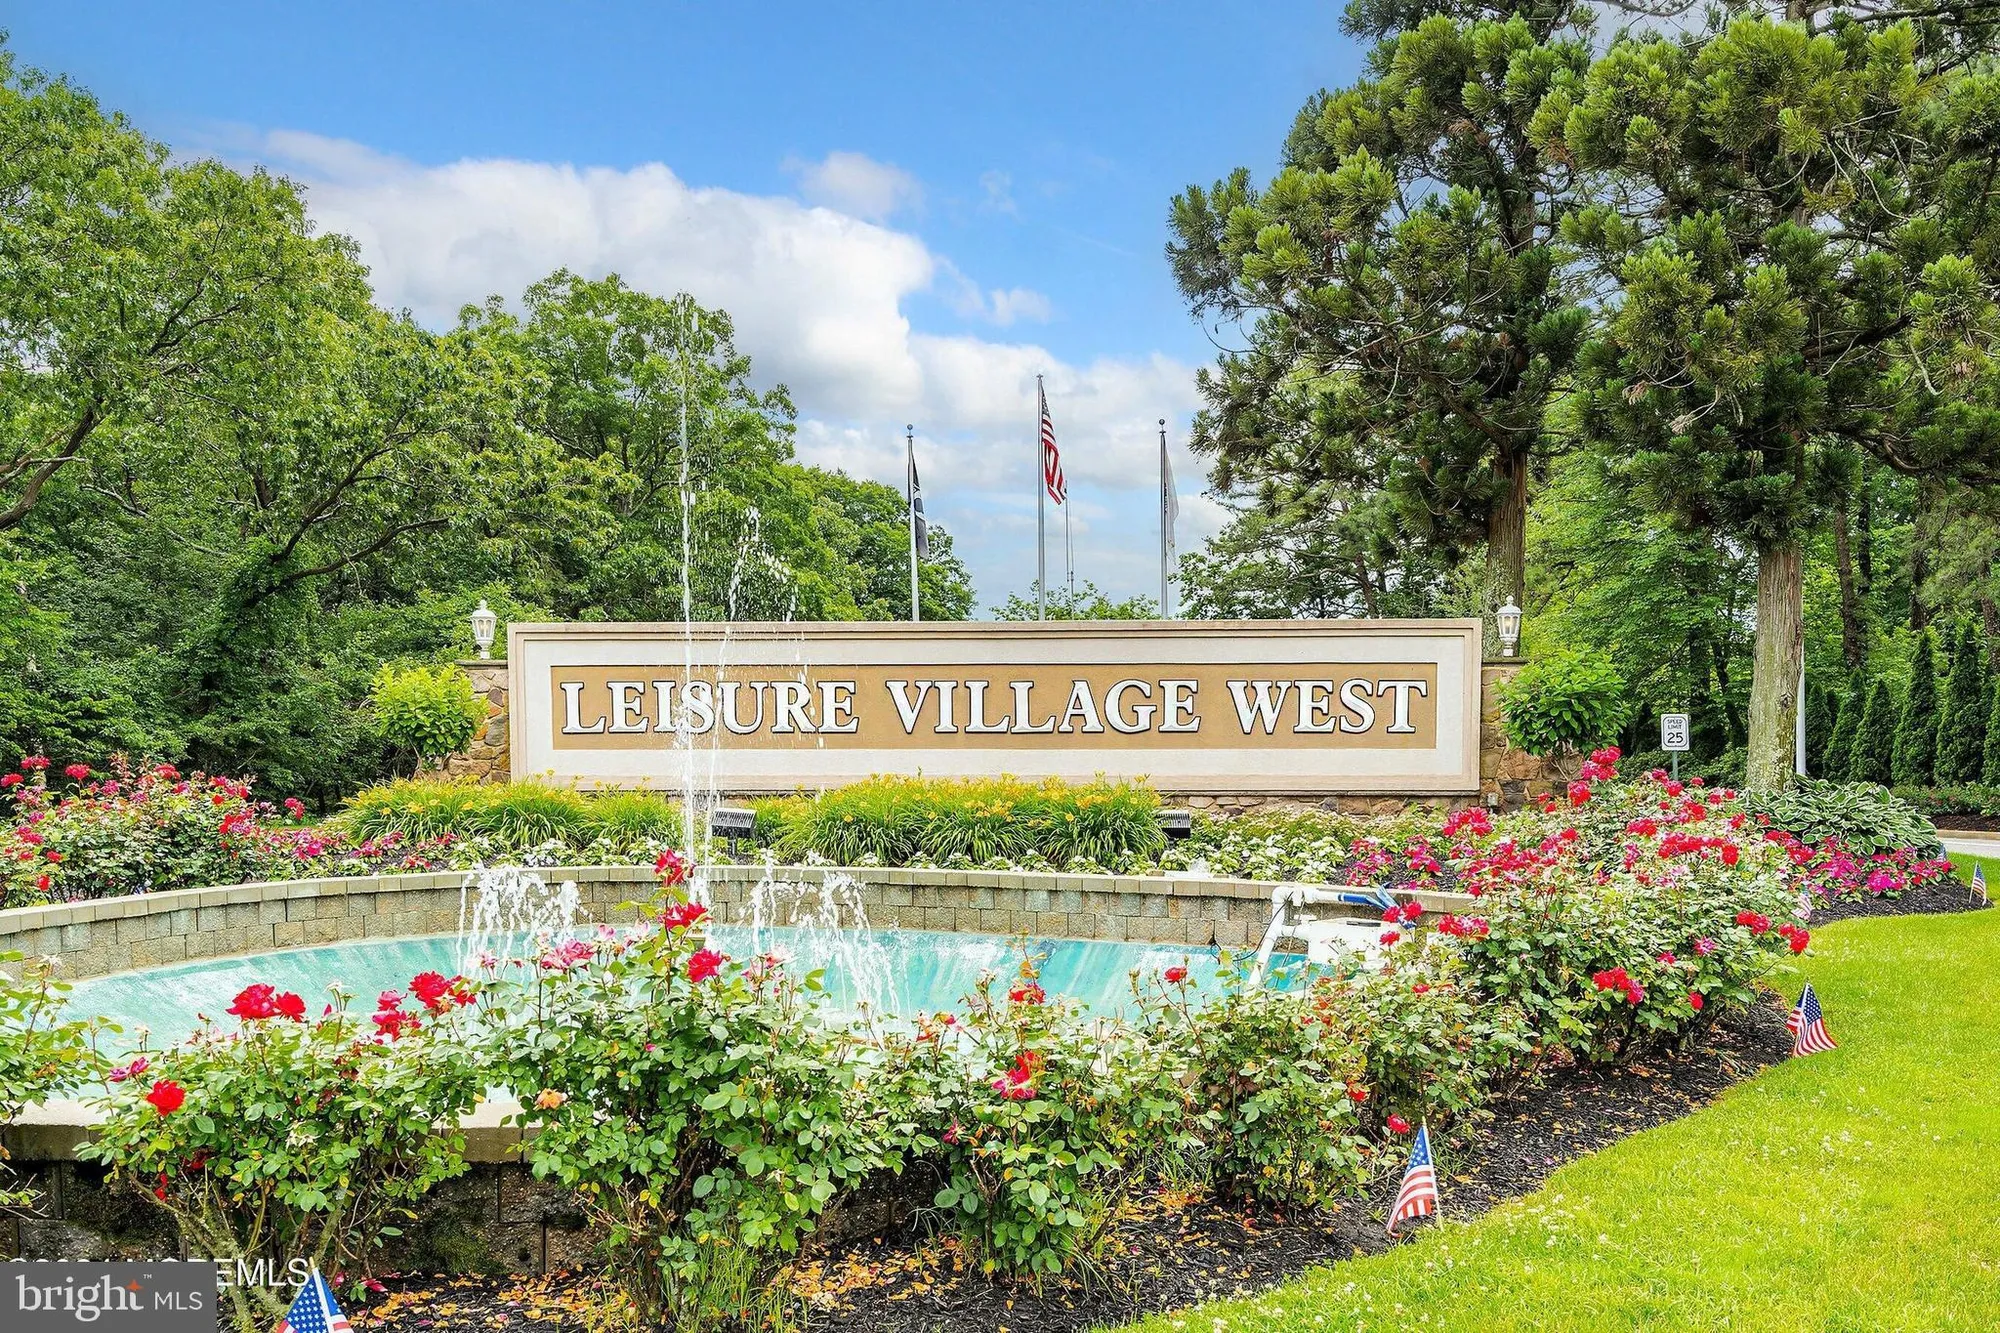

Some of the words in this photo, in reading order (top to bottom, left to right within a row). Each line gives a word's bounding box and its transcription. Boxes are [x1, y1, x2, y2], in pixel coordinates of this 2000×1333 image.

[560, 680, 859, 734] LEISURE
[885, 679, 1201, 734] VILLAGE
[1226, 678, 1428, 734] WEST
[1667, 732, 1684, 743] 25
